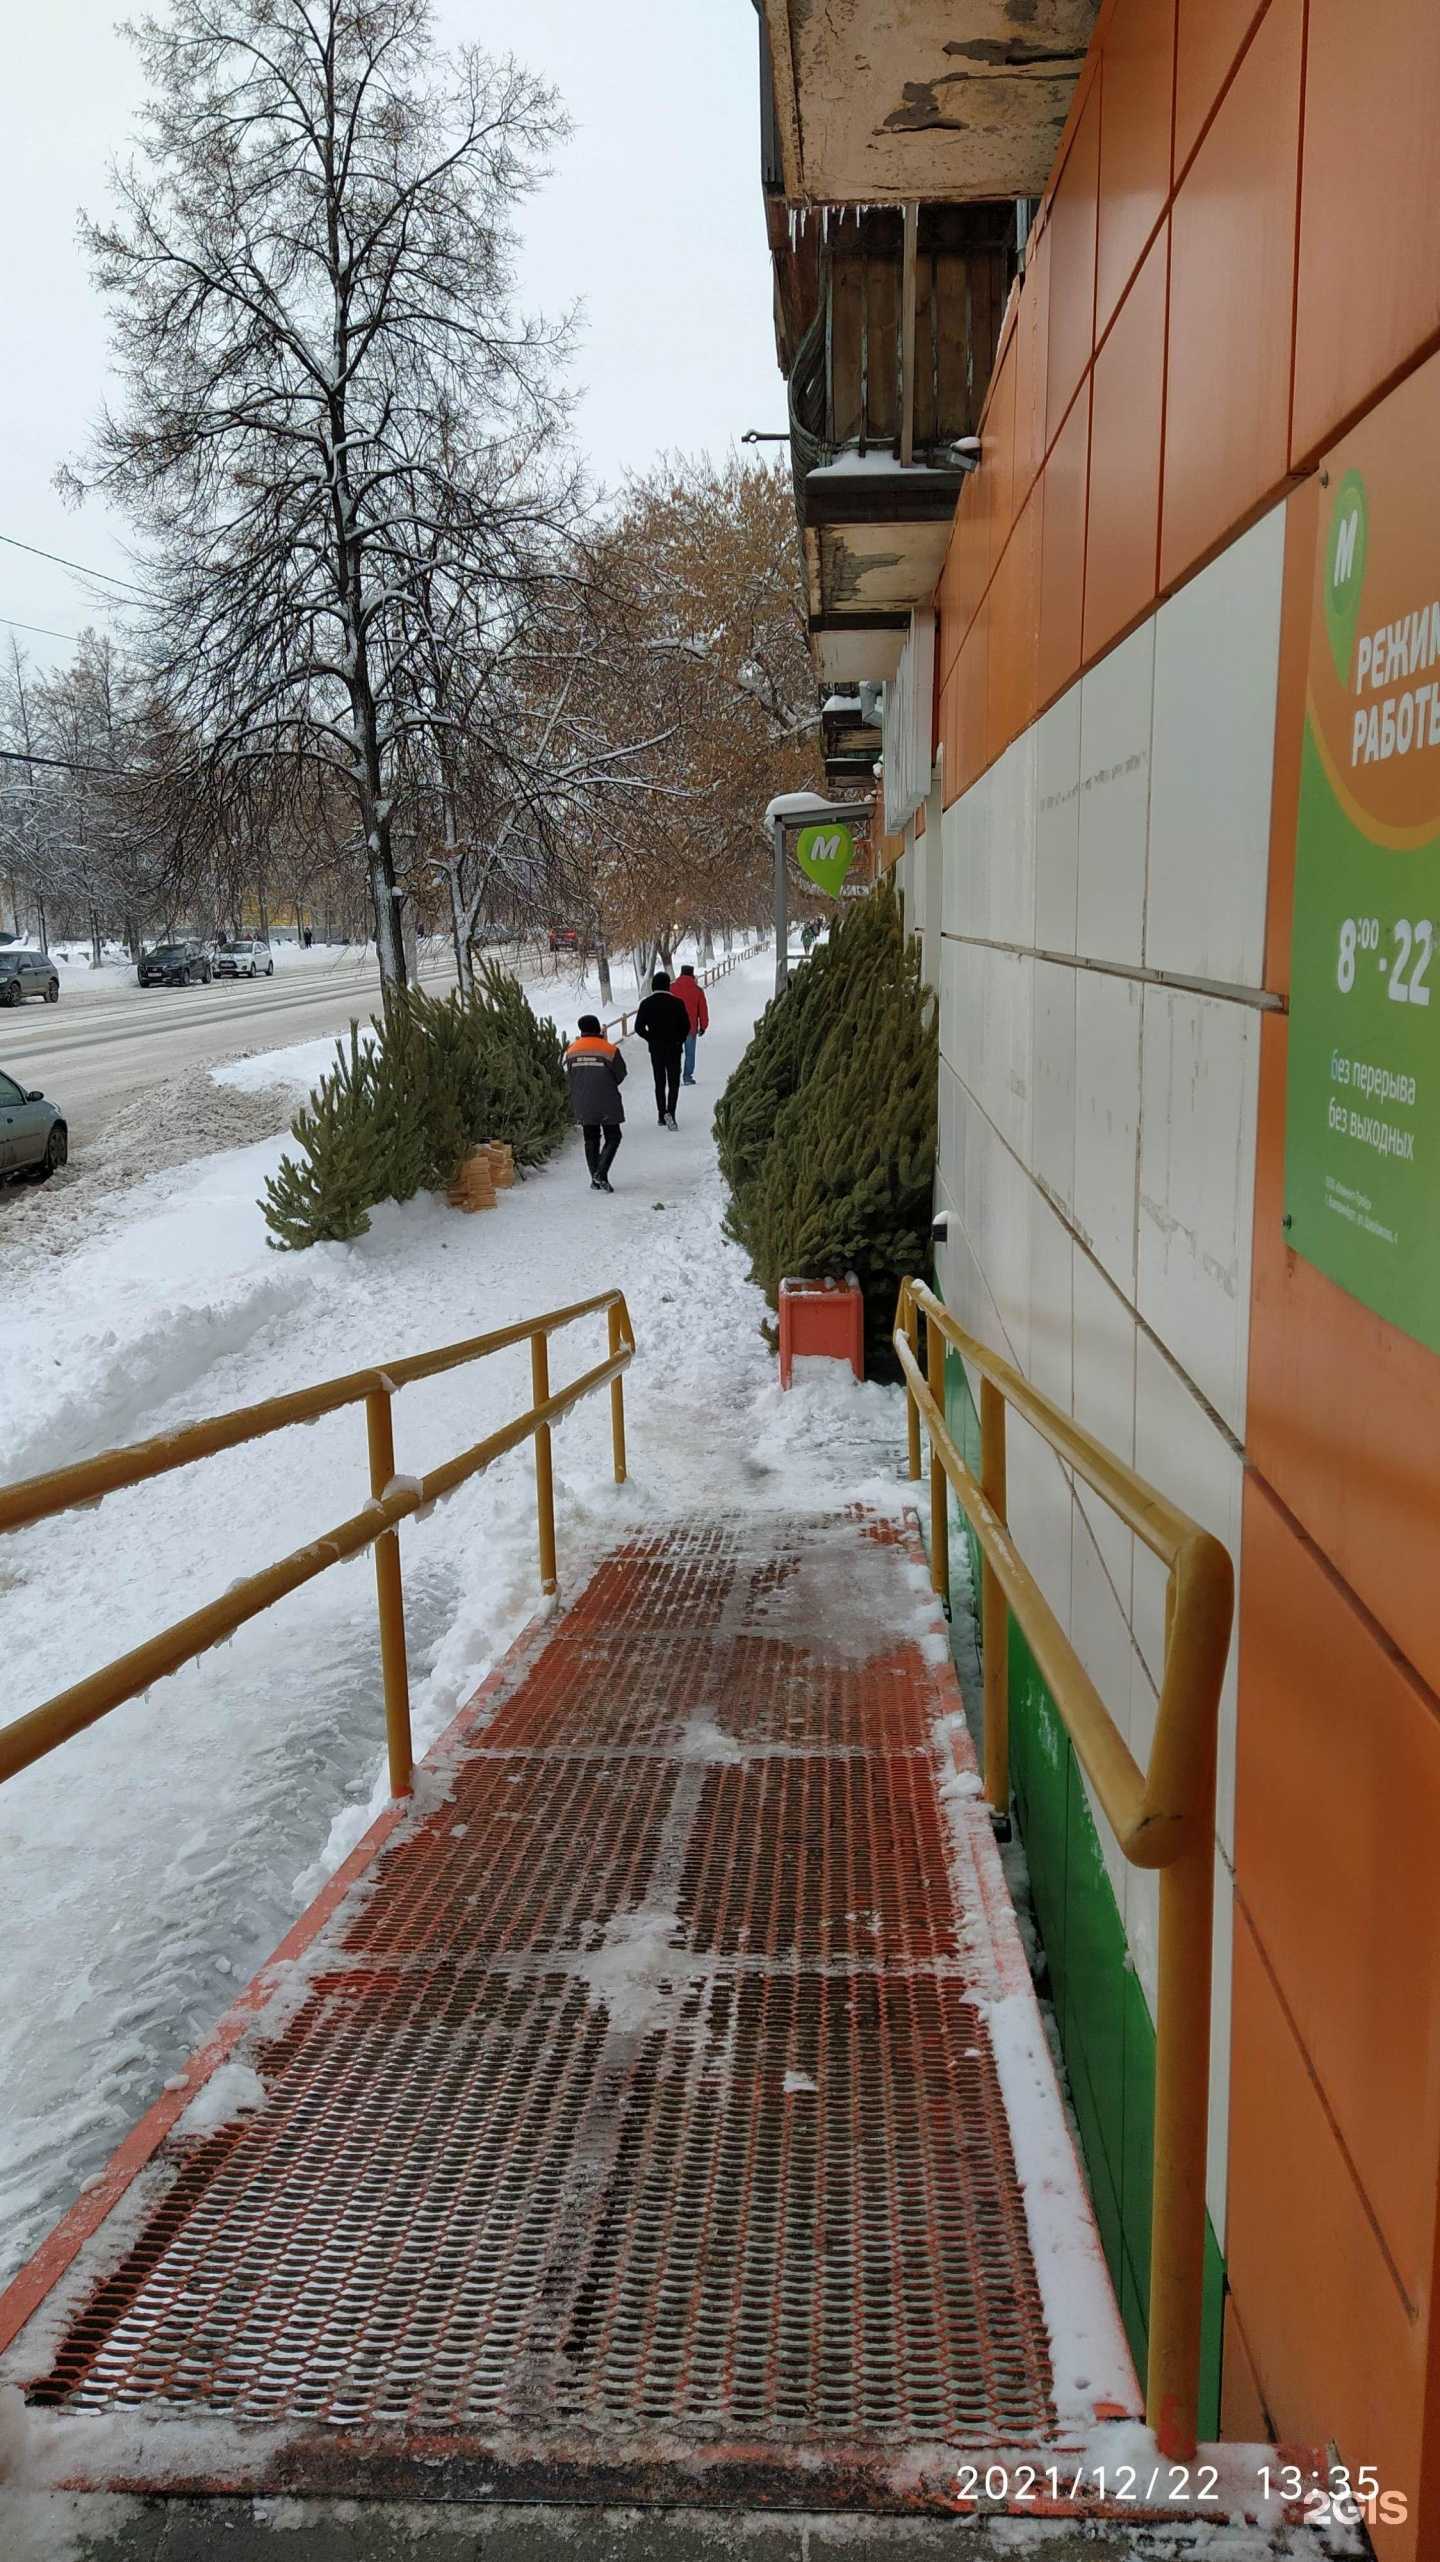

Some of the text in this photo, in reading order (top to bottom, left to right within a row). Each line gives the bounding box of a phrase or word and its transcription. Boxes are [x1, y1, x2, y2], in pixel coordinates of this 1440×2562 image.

[1331, 1048, 1416, 1106] без перерыва
[1328, 1096, 1415, 1161] без выходных
